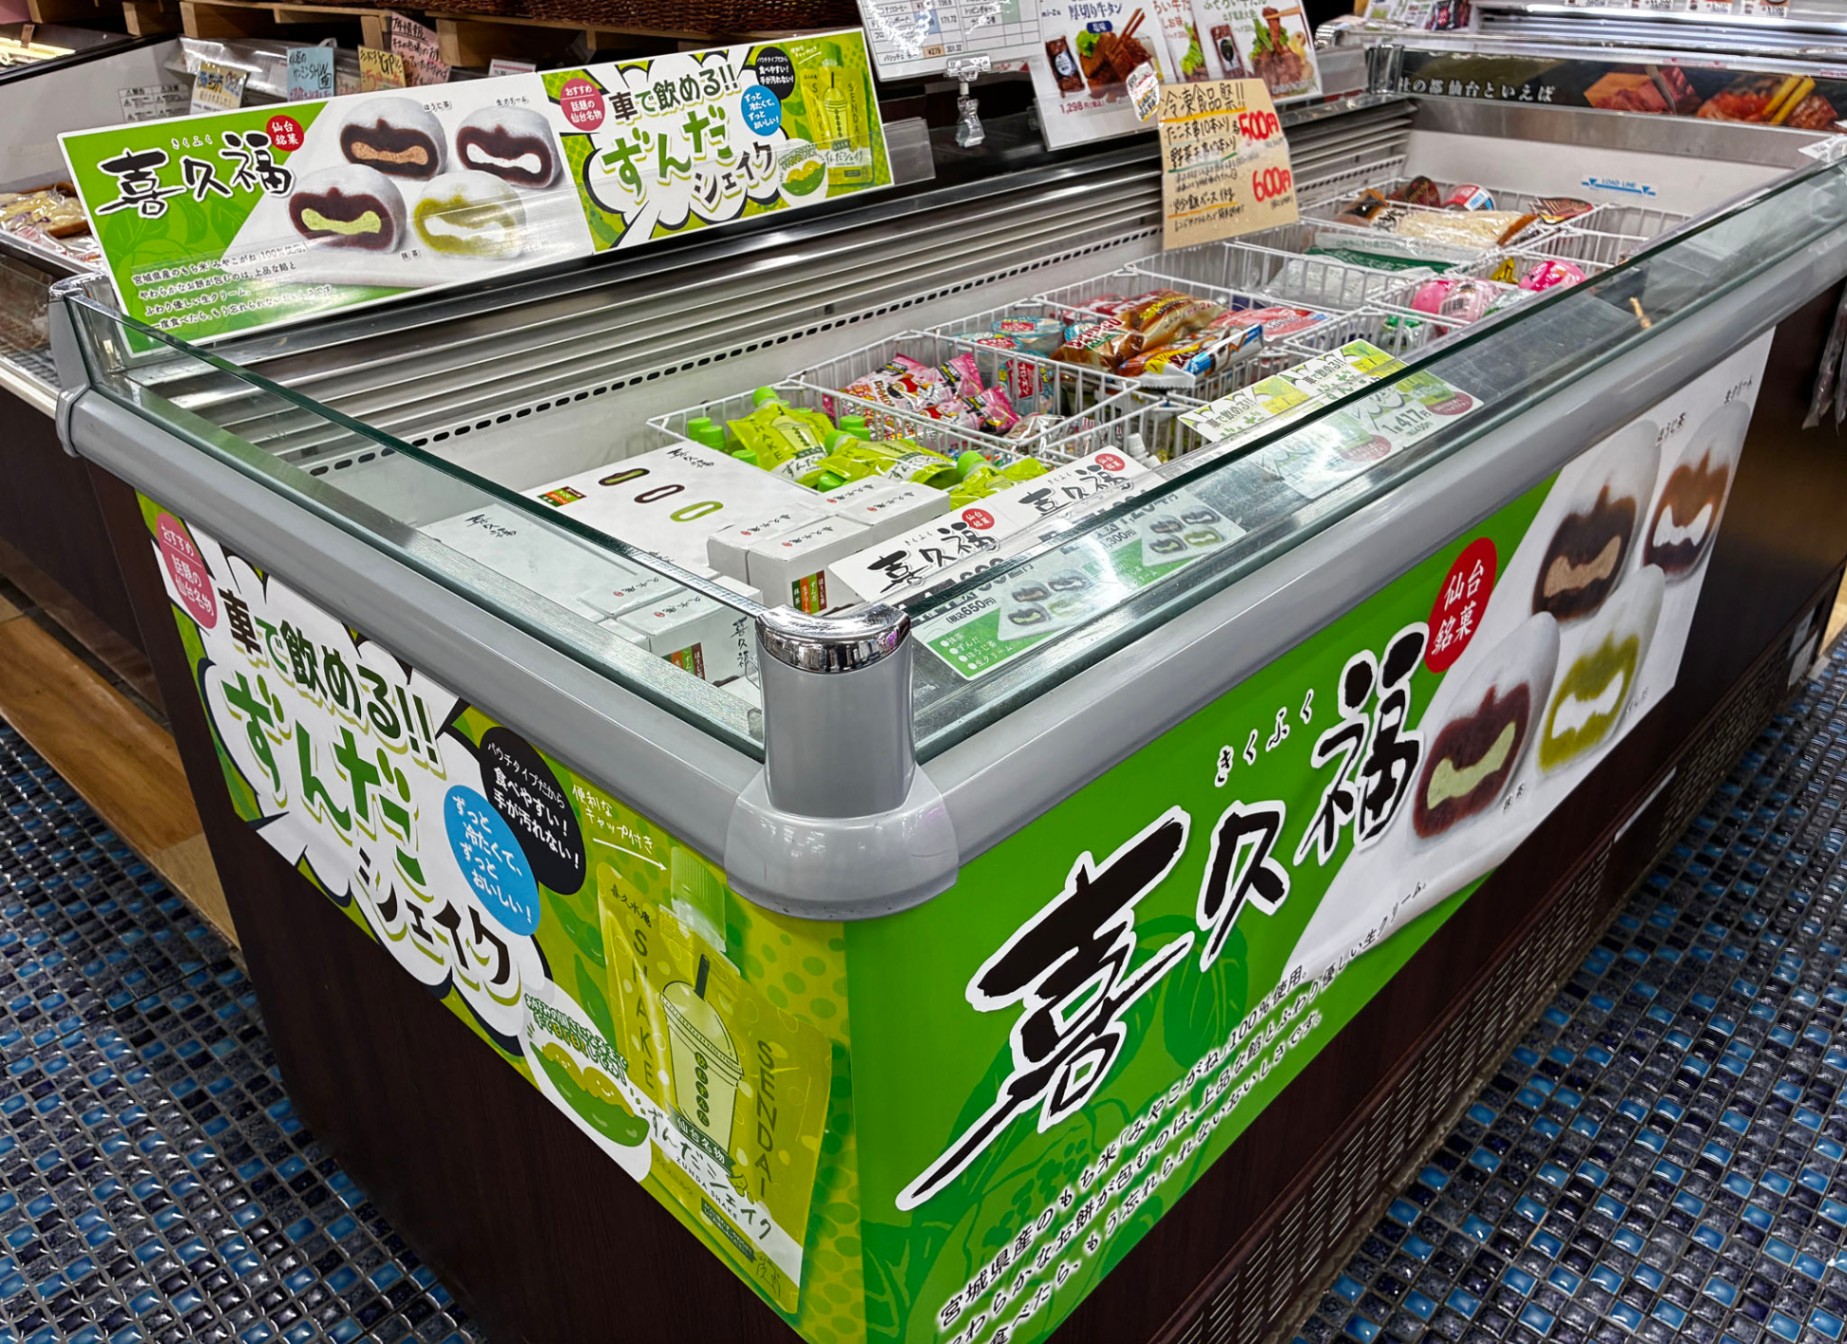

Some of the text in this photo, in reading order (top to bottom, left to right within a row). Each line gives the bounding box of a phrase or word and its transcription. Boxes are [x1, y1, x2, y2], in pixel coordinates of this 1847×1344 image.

[565, 85, 592, 96] おすすめ
[570, 109, 603, 124] 仙台名物
[571, 101, 594, 112] 話題の
[744, 92, 762, 102] ずっと
[748, 111, 765, 120] ずっと
[271, 120, 293, 133] 仙台
[602, 104, 734, 198] ずんだ
[97, 132, 293, 215] 喜久福
[693, 141, 772, 204] シェイク
[161, 523, 194, 557] おすすめ
[171, 553, 203, 588] 話題の
[175, 573, 215, 617] 仙台名物
[1444, 559, 1485, 611] 仙台
[1431, 600, 1477, 656] 銘菓
[1217, 692, 1313, 784] きくふく
[221, 670, 427, 887] ずんだ
[488, 743, 566, 810] パウチタイプだから
[494, 767, 568, 836] 食べやすい!
[572, 784, 613, 818] 便利な
[453, 795, 493, 834] ずっと
[494, 788, 579, 869] 手が汚れない!
[585, 807, 654, 856] キャップ付き
[460, 841, 499, 880] ずっと
[357, 847, 511, 986] シェイク
[472, 869, 532, 924] おいしい!
[910, 631, 1426, 1200] 喜久福
[677, 1116, 726, 1166] 仙台名物
[755, 1039, 778, 1198] SENDAI
[648, 1107, 772, 1241] ずんだシェイク
[675, 1156, 708, 1192] ZUNDA
[710, 1190, 739, 1222] SHAKE
